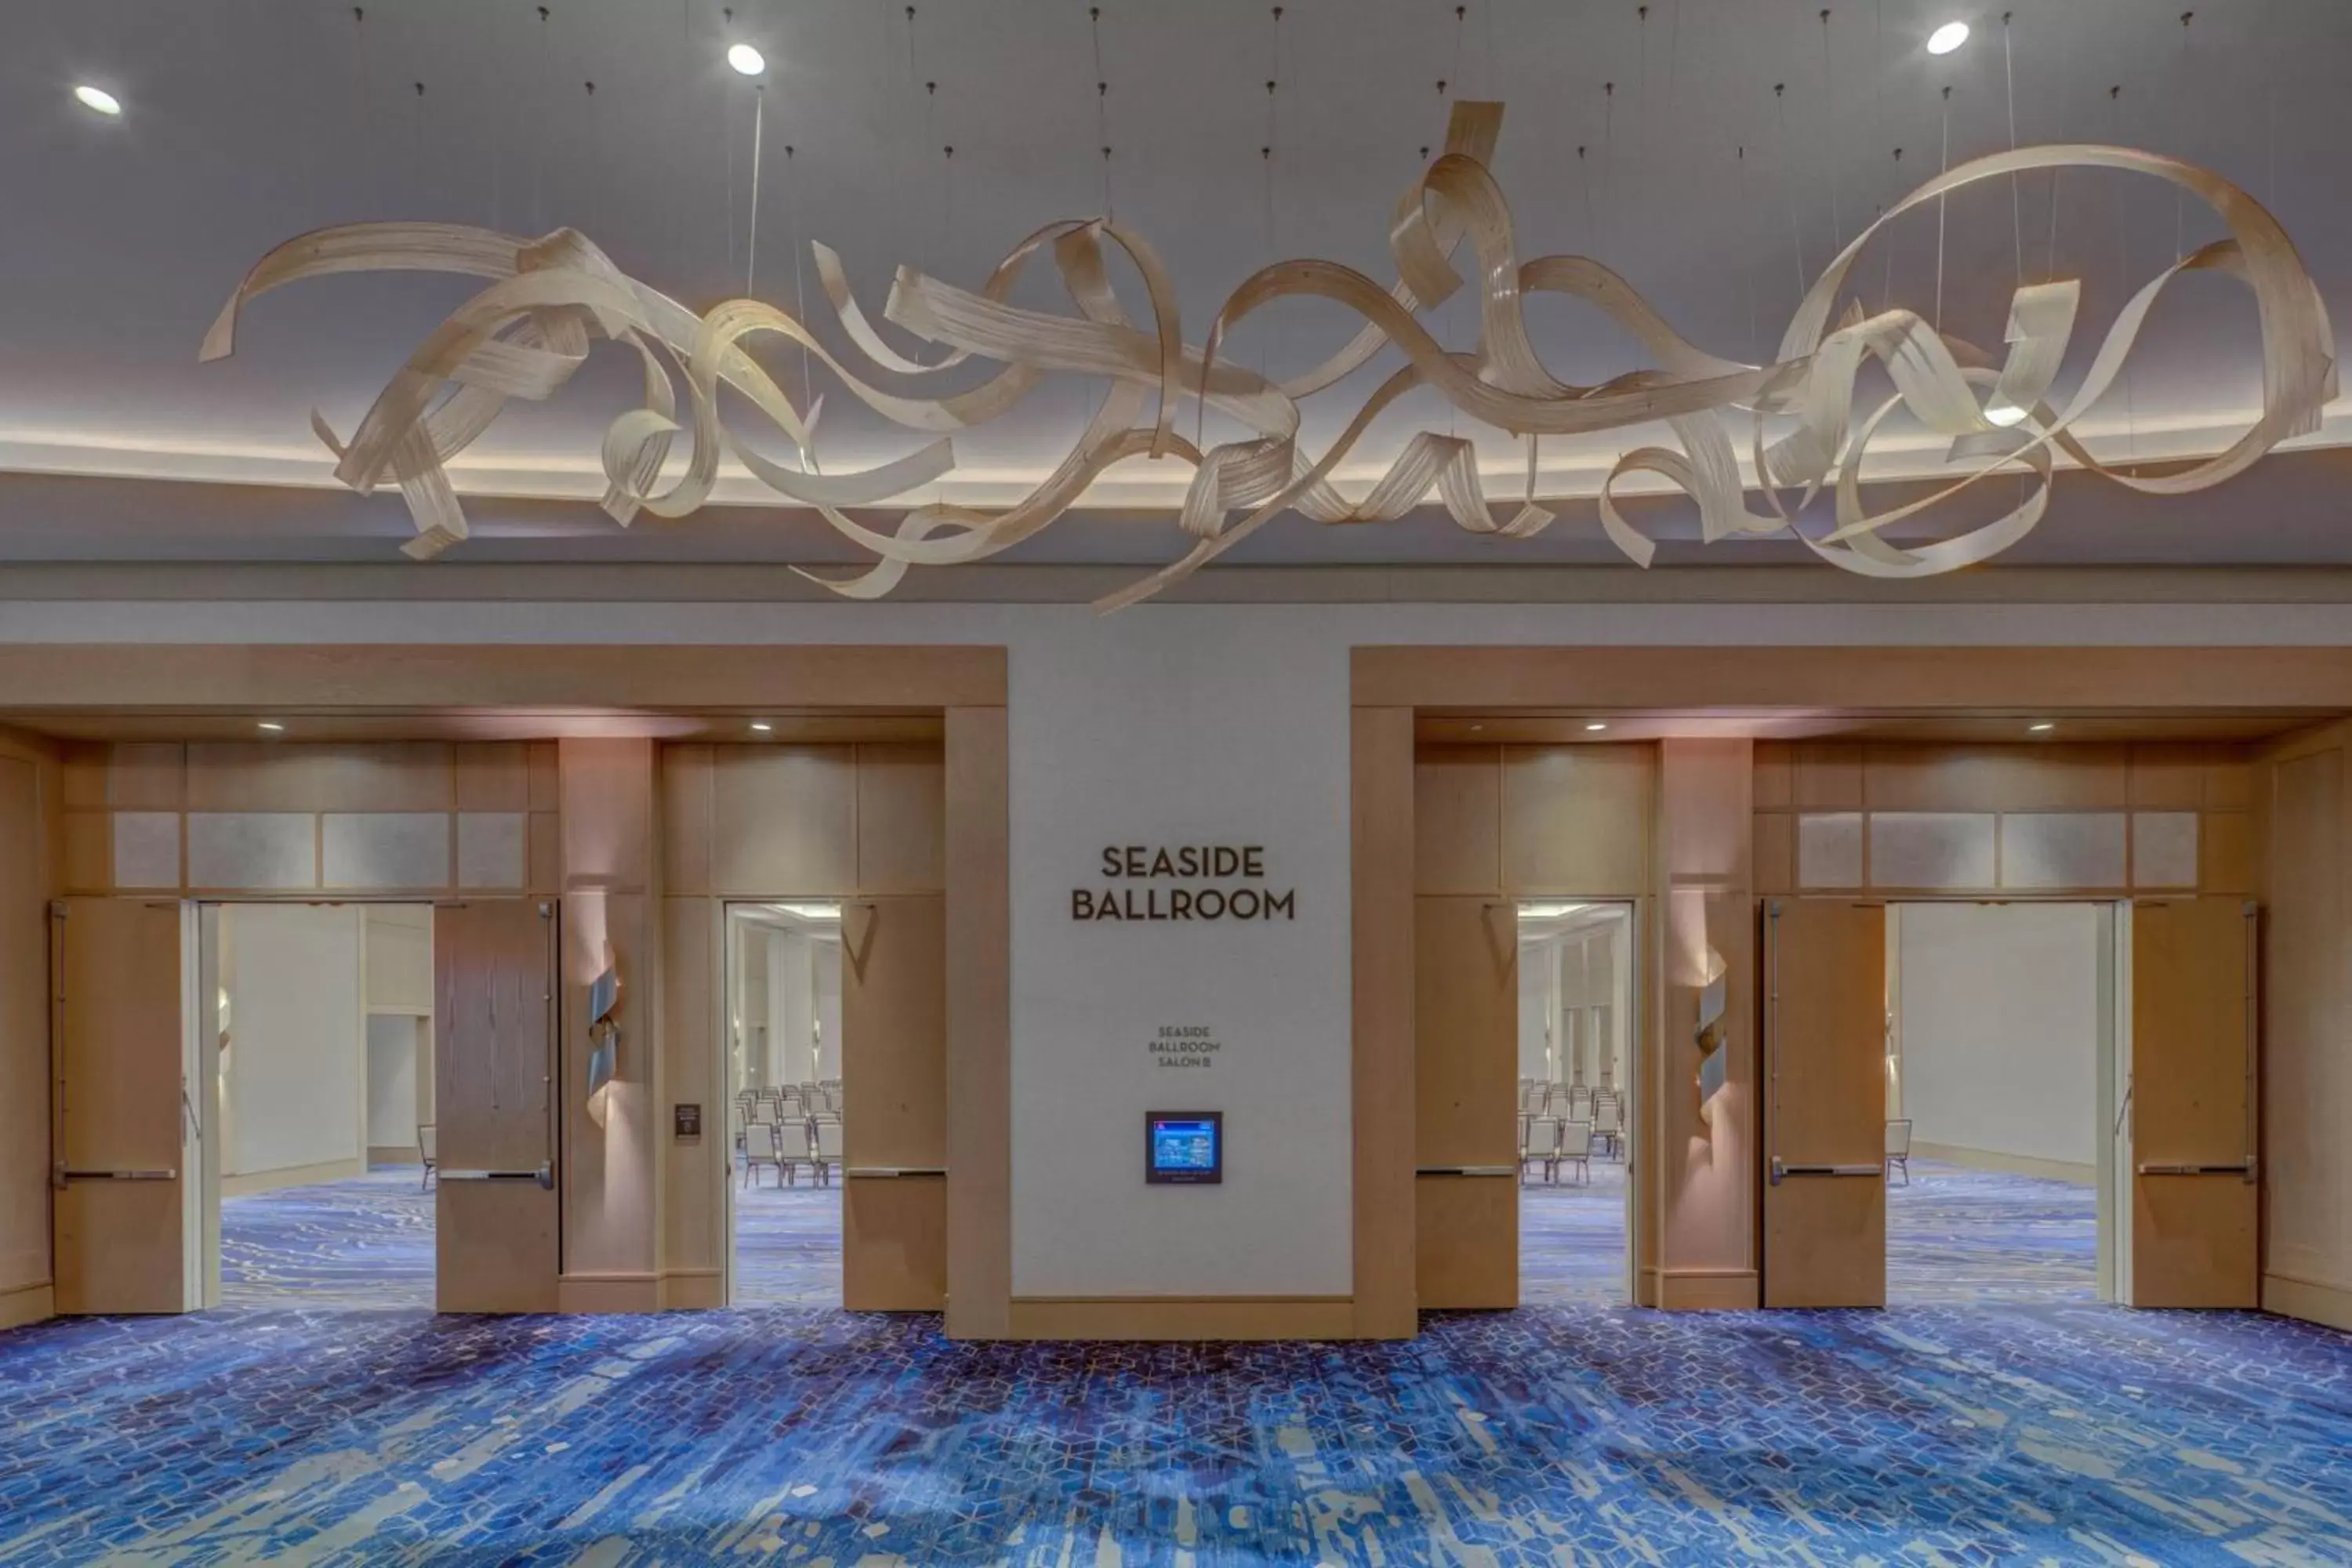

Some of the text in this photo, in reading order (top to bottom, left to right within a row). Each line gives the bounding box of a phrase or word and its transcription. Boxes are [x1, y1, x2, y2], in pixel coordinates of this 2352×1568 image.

[1101, 846, 1265, 878] SEASIDE
[1071, 888, 1295, 920] BALLROOM
[1159, 1025, 1210, 1037] SEASIDE
[1149, 1041, 1221, 1053] BALLROOM
[1159, 1057, 1200, 1067] SALON
